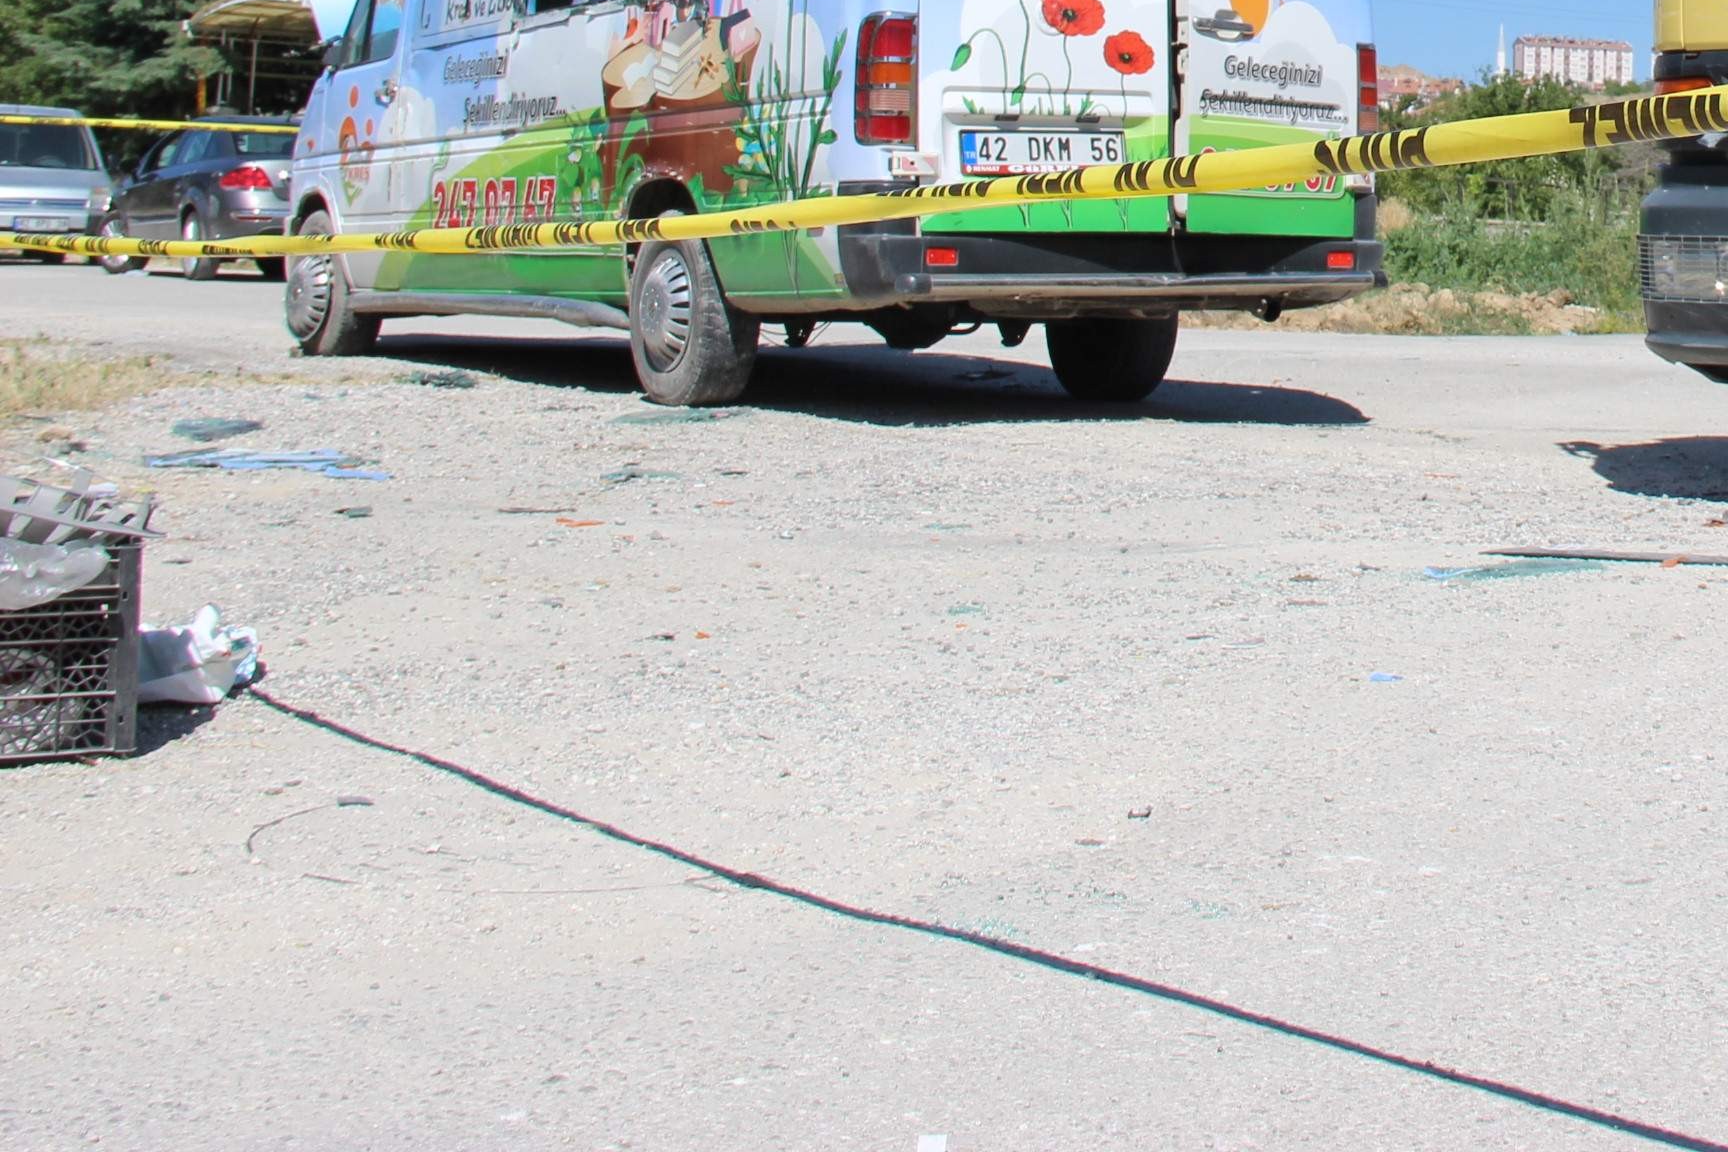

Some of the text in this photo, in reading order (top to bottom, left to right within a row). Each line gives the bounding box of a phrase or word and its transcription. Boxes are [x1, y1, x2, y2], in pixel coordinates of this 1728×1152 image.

[1224, 54, 1323, 90] Geleceğinizi
[979, 136, 1119, 163] 42 DKM 56
